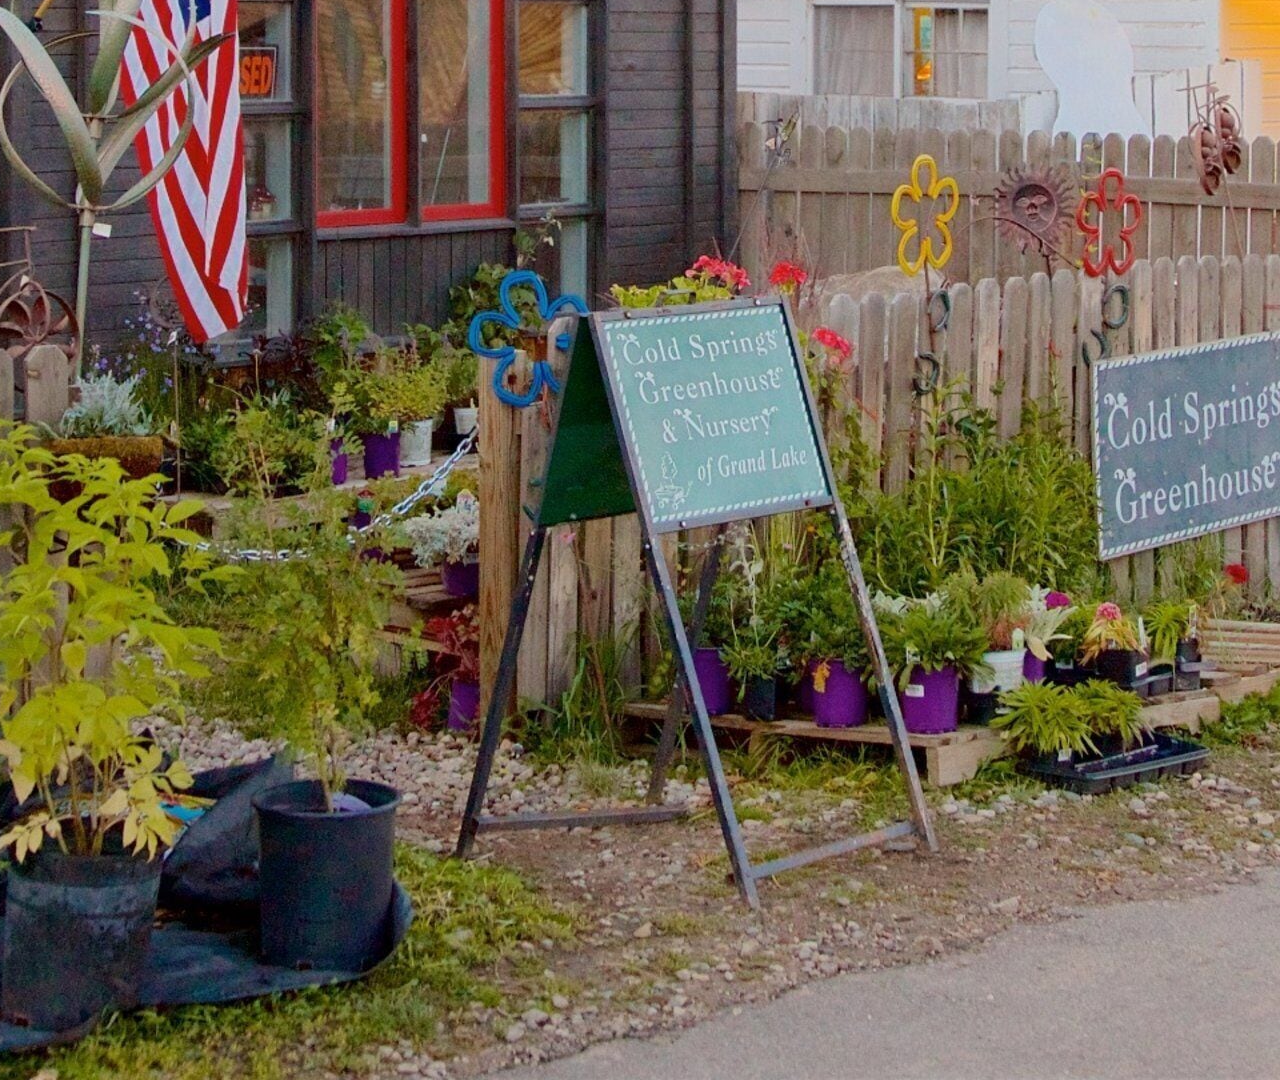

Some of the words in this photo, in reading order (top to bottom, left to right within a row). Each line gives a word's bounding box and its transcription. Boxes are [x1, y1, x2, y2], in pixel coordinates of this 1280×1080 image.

[240, 55, 273, 95] SED
[618, 333, 681, 367] Cold
[689, 329, 778, 362] Springs
[635, 367, 783, 405] Greenhouse
[662, 417, 677, 444] &
[675, 406, 778, 441] Nursery
[1104, 392, 1173, 450] Cold
[697, 457, 713, 486] of
[718, 450, 766, 479] Grand
[771, 445, 808, 471] Lake
[1114, 452, 1280, 524] Greenhouse
